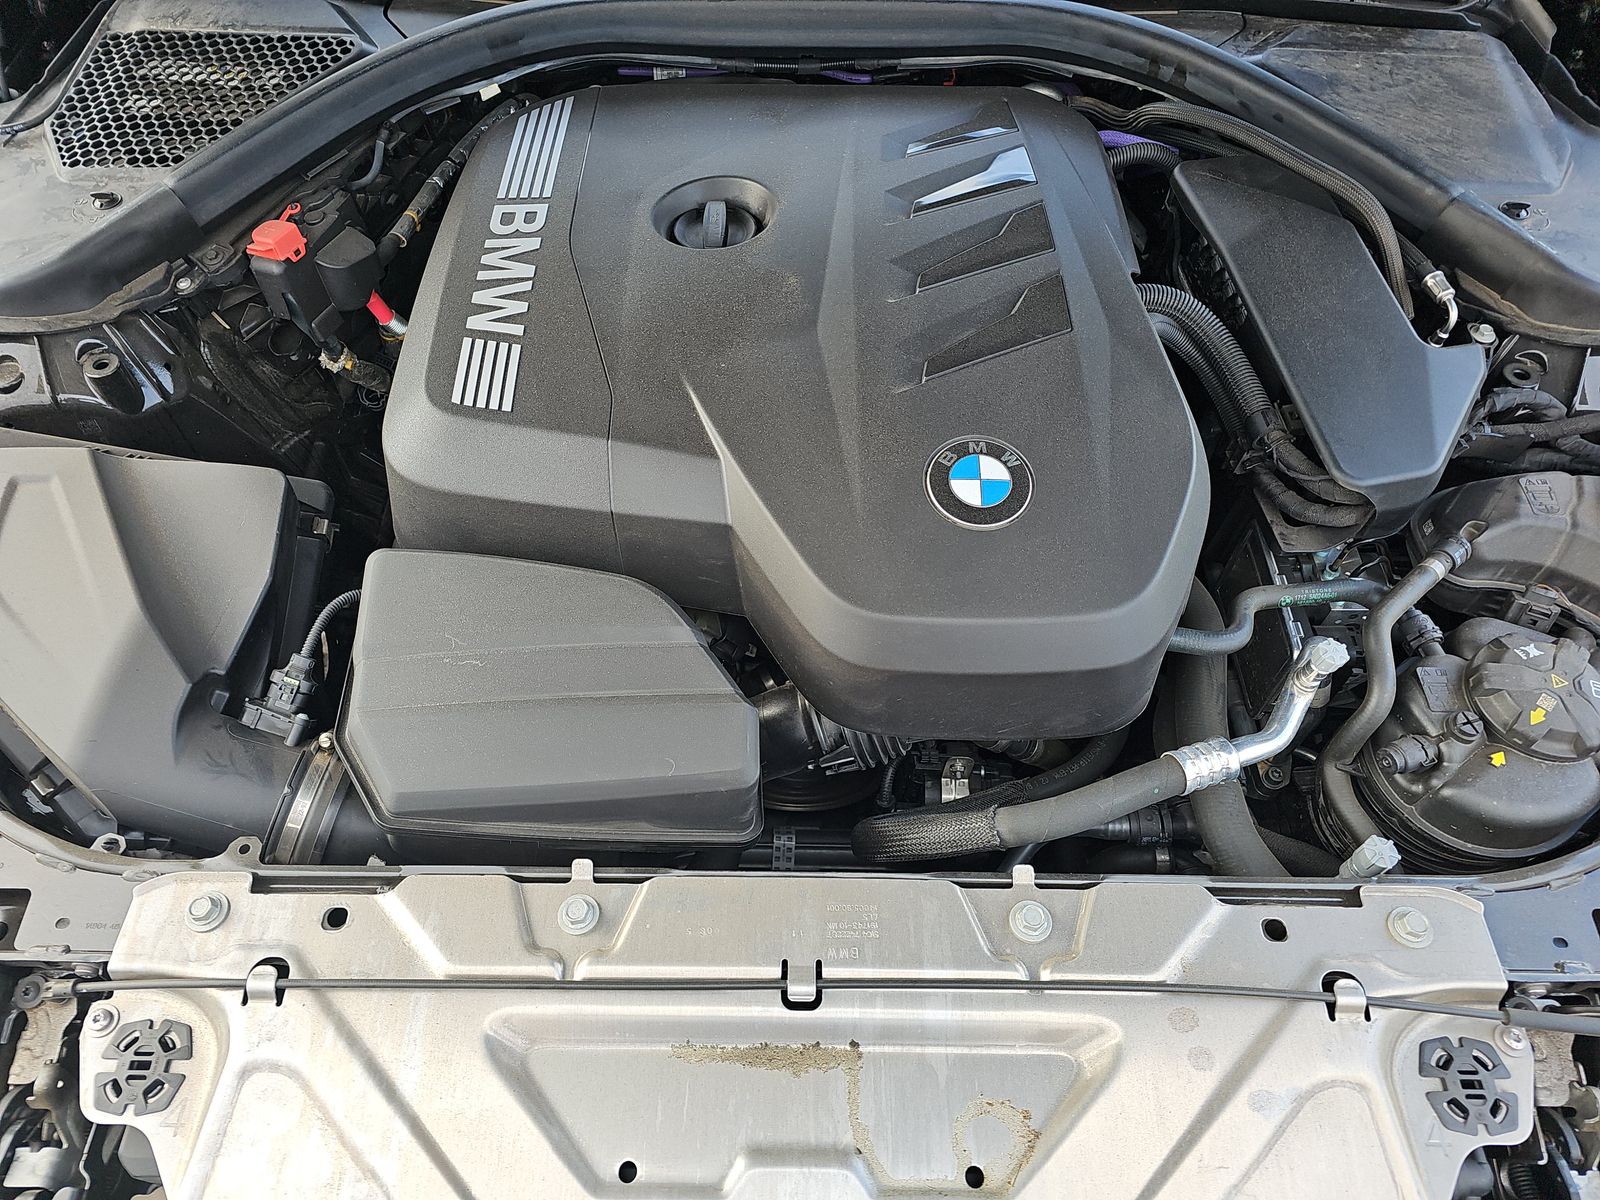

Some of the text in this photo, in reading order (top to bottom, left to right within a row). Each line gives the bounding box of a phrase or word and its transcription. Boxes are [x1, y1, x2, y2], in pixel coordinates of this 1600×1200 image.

[465, 203, 550, 336] BMW
[937, 440, 1022, 468] BMW
[827, 947, 859, 960] BMW
